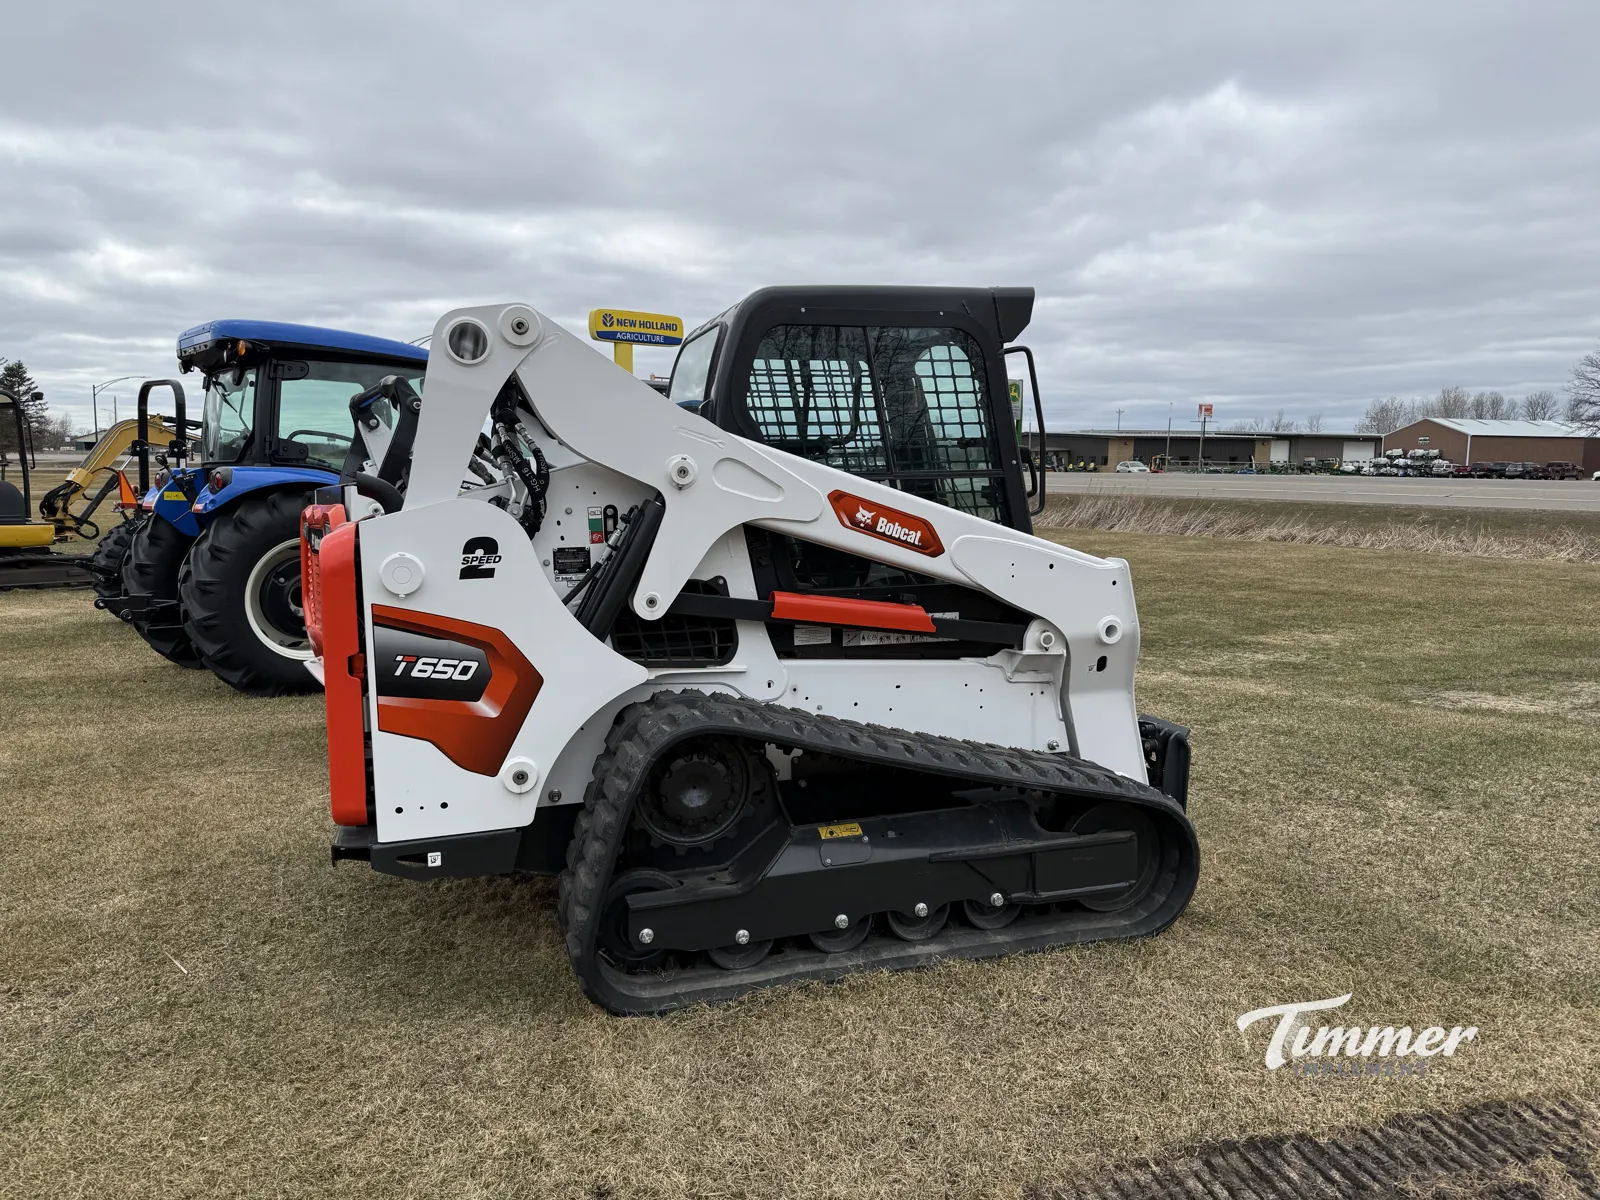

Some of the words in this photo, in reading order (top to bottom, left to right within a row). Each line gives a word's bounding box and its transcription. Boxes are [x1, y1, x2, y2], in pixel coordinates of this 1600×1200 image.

[616, 318, 637, 328] NEW
[639, 320, 678, 331] HOLLAND
[616, 332, 665, 343] AGRICULTURE
[876, 516, 921, 546] Bobcat
[459, 536, 499, 580] 2
[461, 554, 502, 566] SPEED
[394, 655, 480, 681] T650
